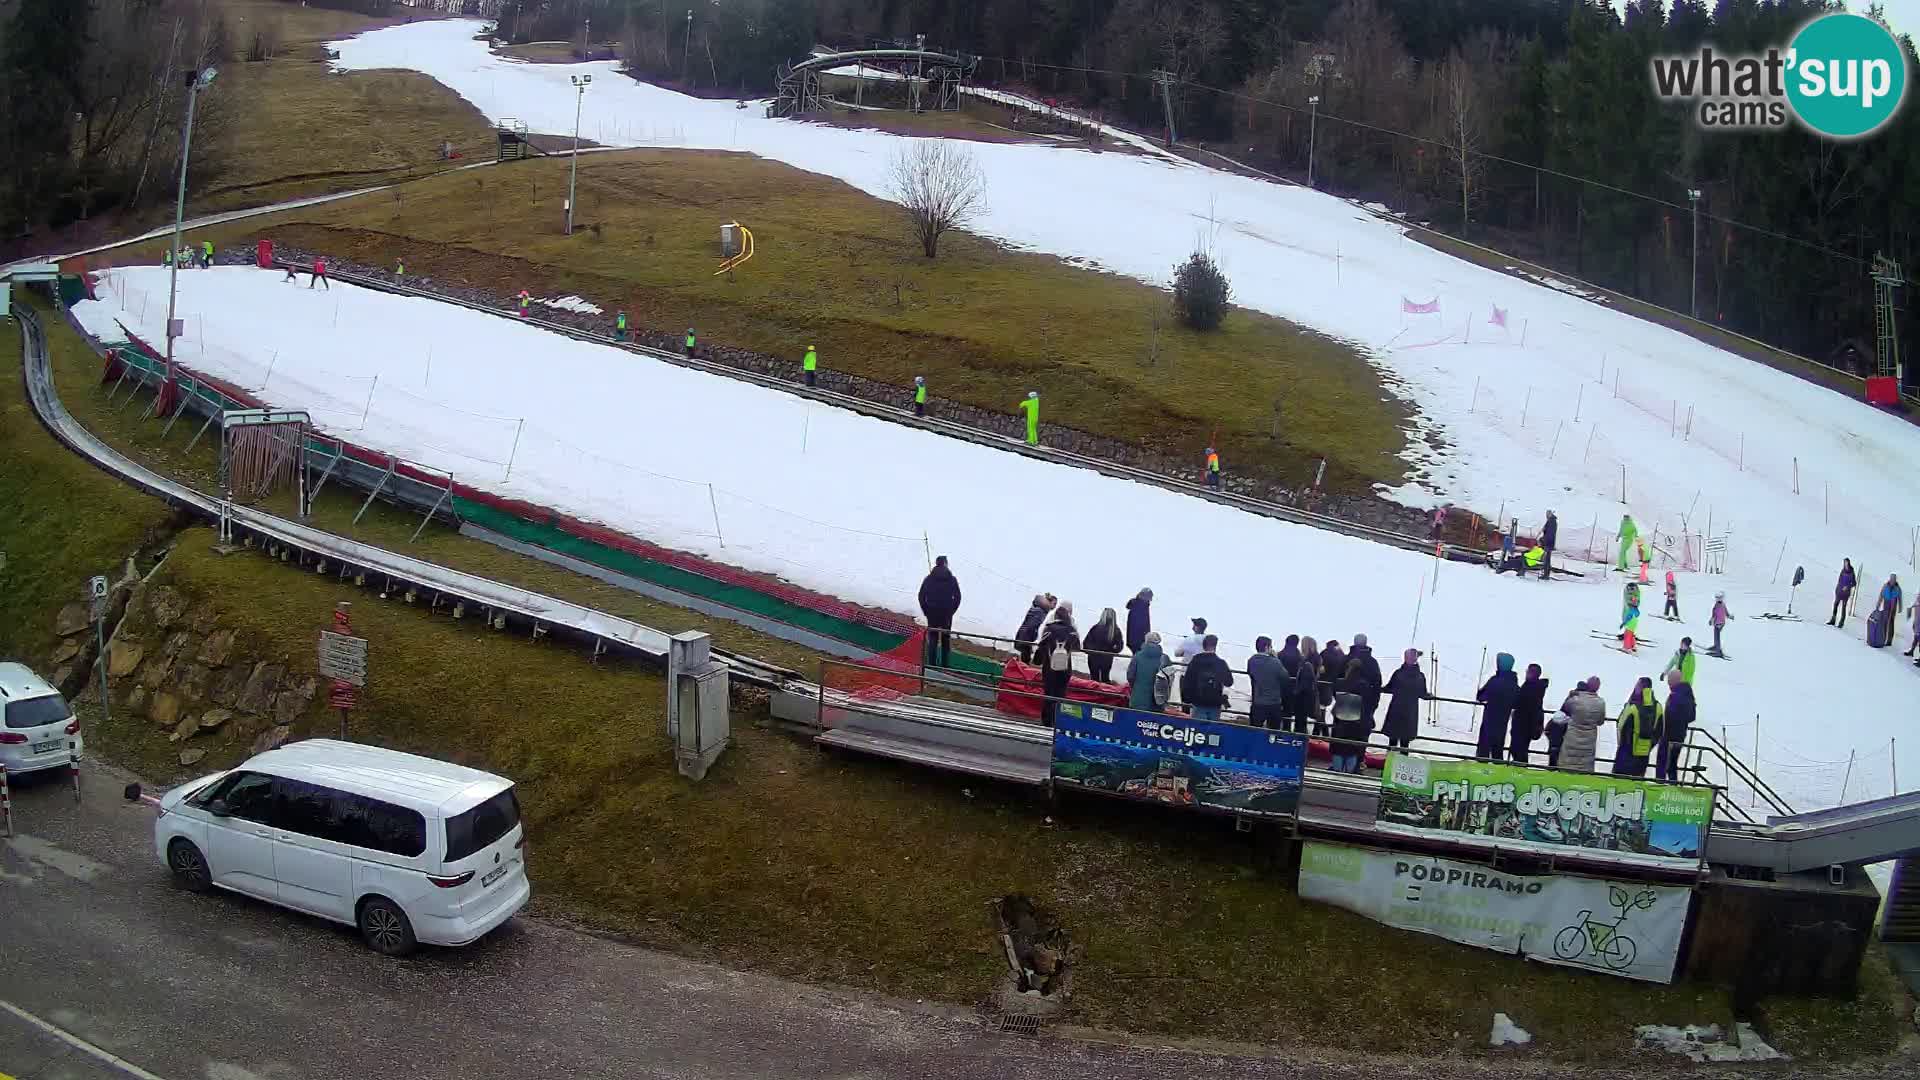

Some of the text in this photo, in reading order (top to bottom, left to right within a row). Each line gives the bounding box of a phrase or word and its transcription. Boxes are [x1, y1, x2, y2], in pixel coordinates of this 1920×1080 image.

[1160, 724, 1206, 747] Celje
[1473, 783, 1515, 803] nas
[1517, 785, 1644, 822] dogaja!
[1395, 861, 1543, 895] PODPIRAMO
